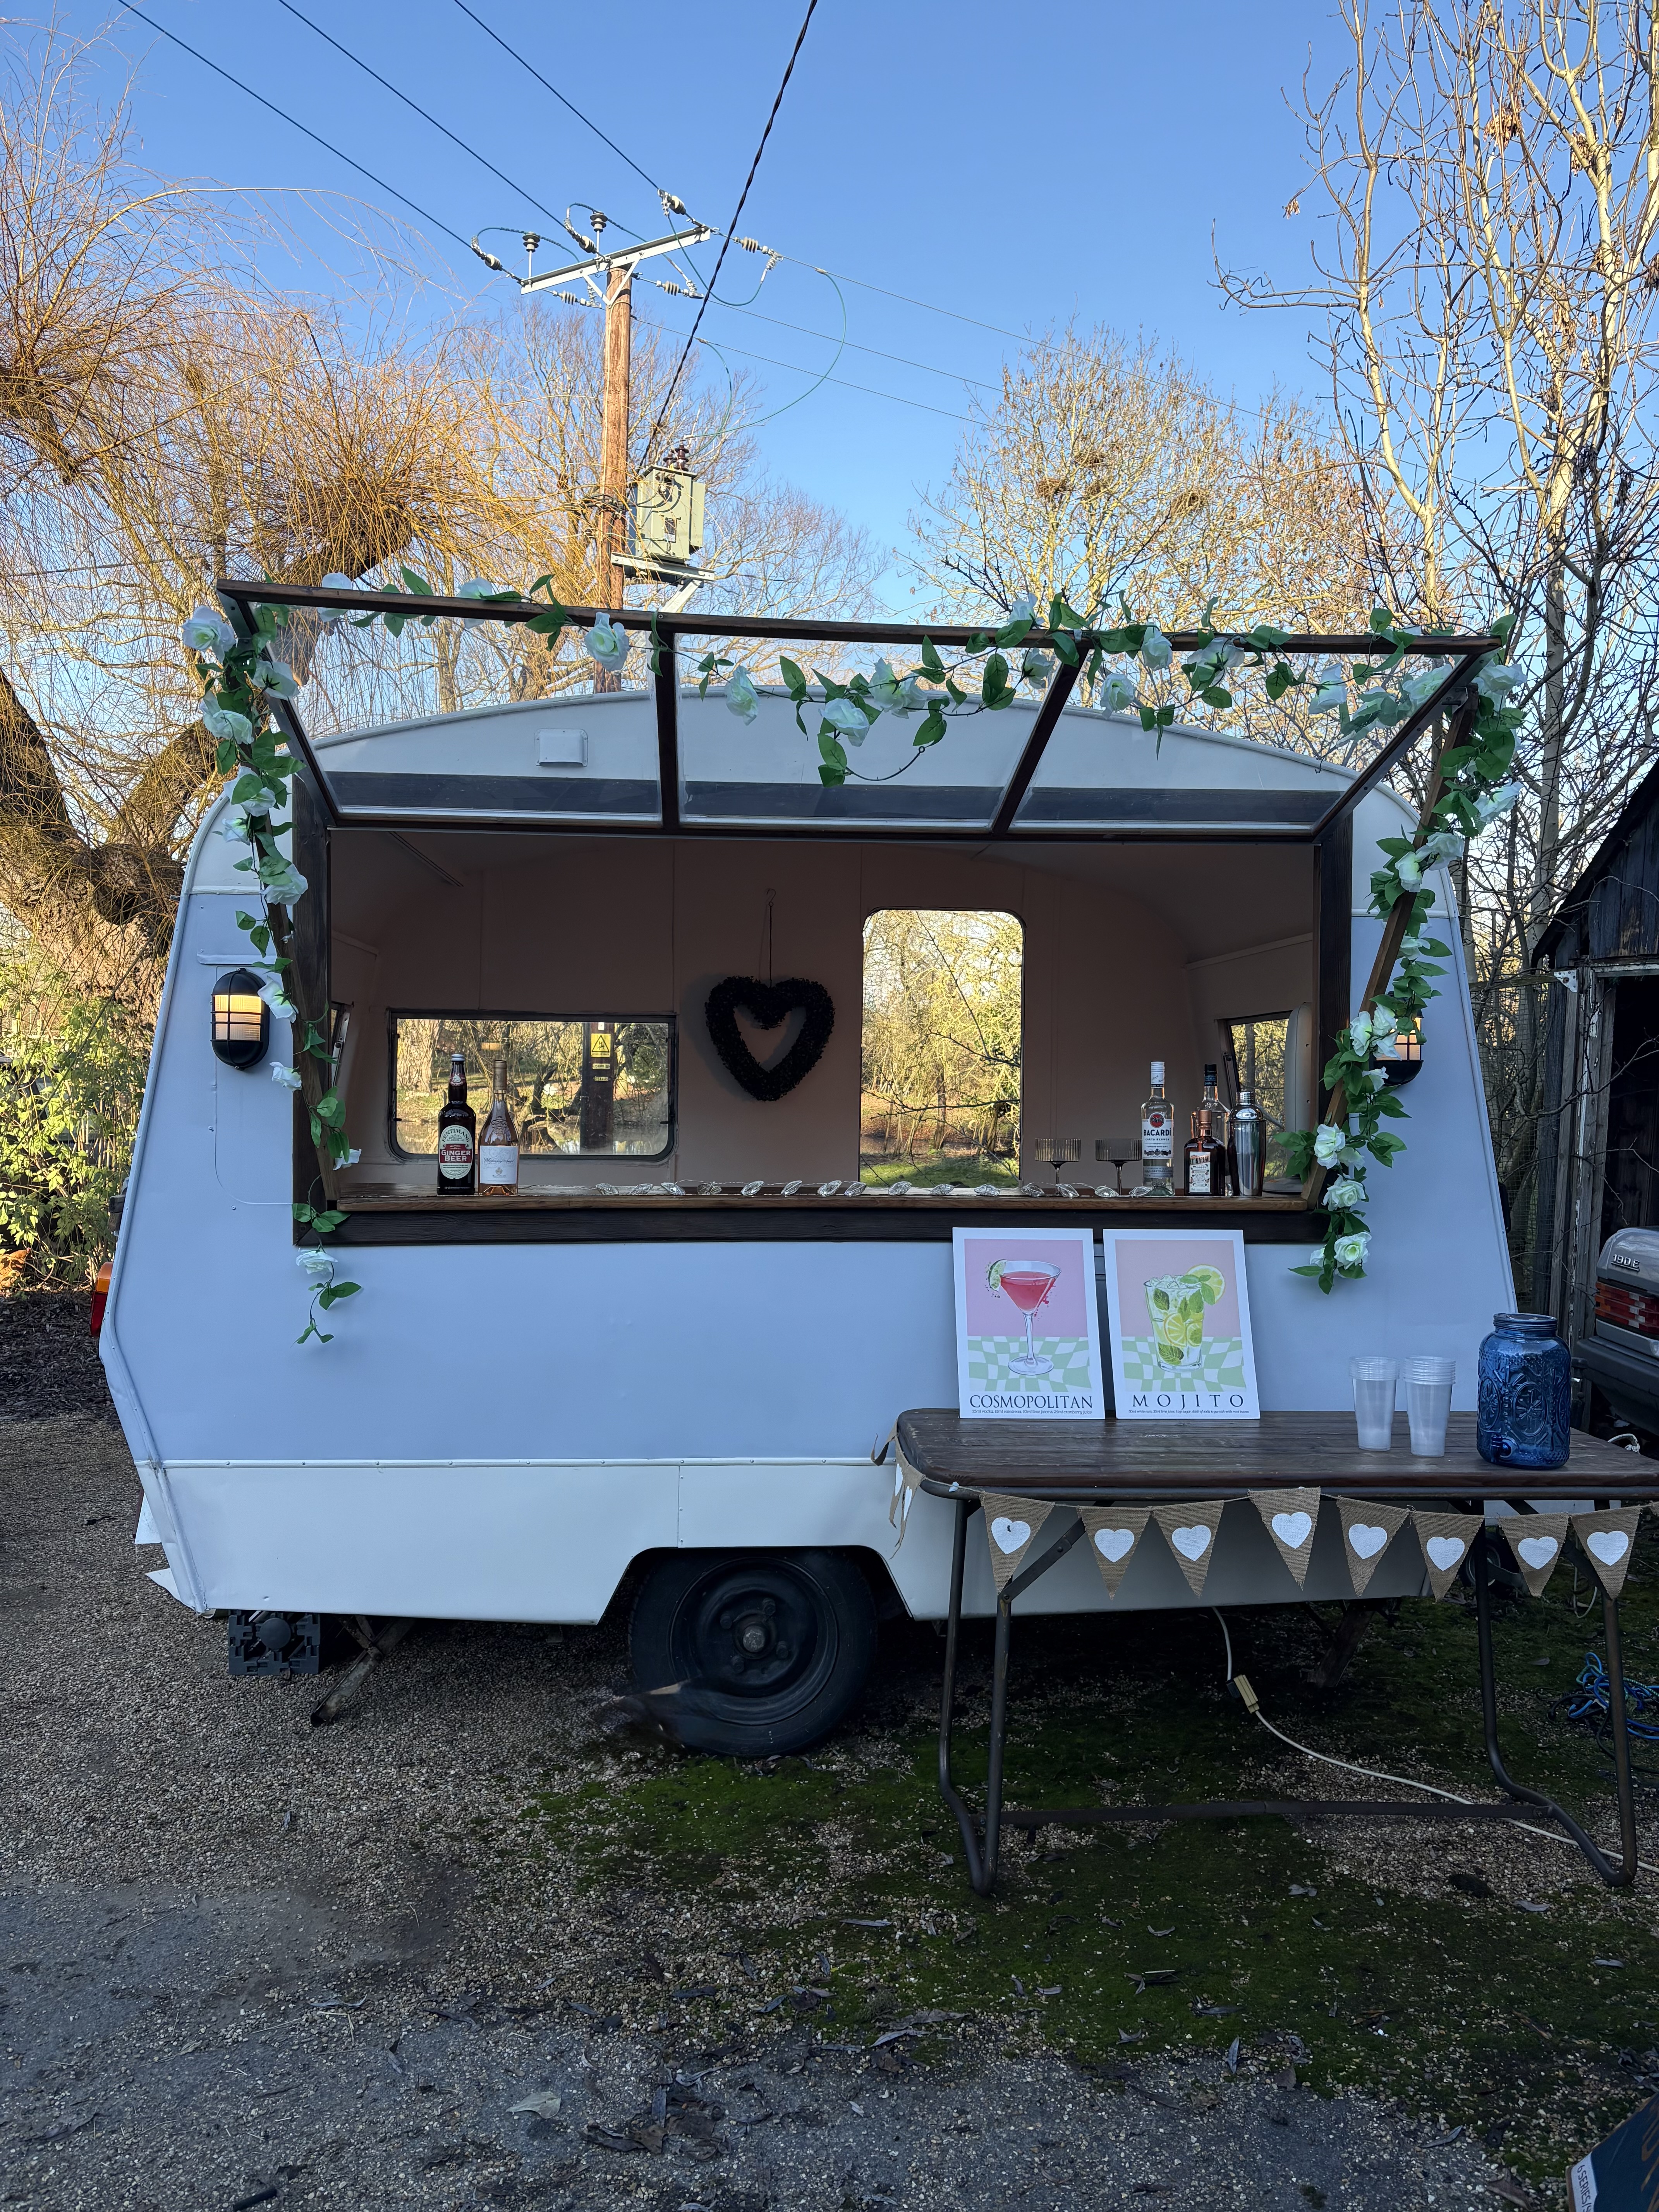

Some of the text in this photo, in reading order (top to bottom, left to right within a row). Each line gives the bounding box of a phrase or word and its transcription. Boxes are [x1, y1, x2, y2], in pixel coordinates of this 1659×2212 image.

[442, 1128, 469, 1142] FENTIMANS
[1144, 1128, 1171, 1136] BACARDÍ
[1613, 1254, 1640, 1268] 190 E
[970, 1395, 1092, 1408] COSMOPOLITAN
[1133, 1394, 1243, 1410] MOJITO
